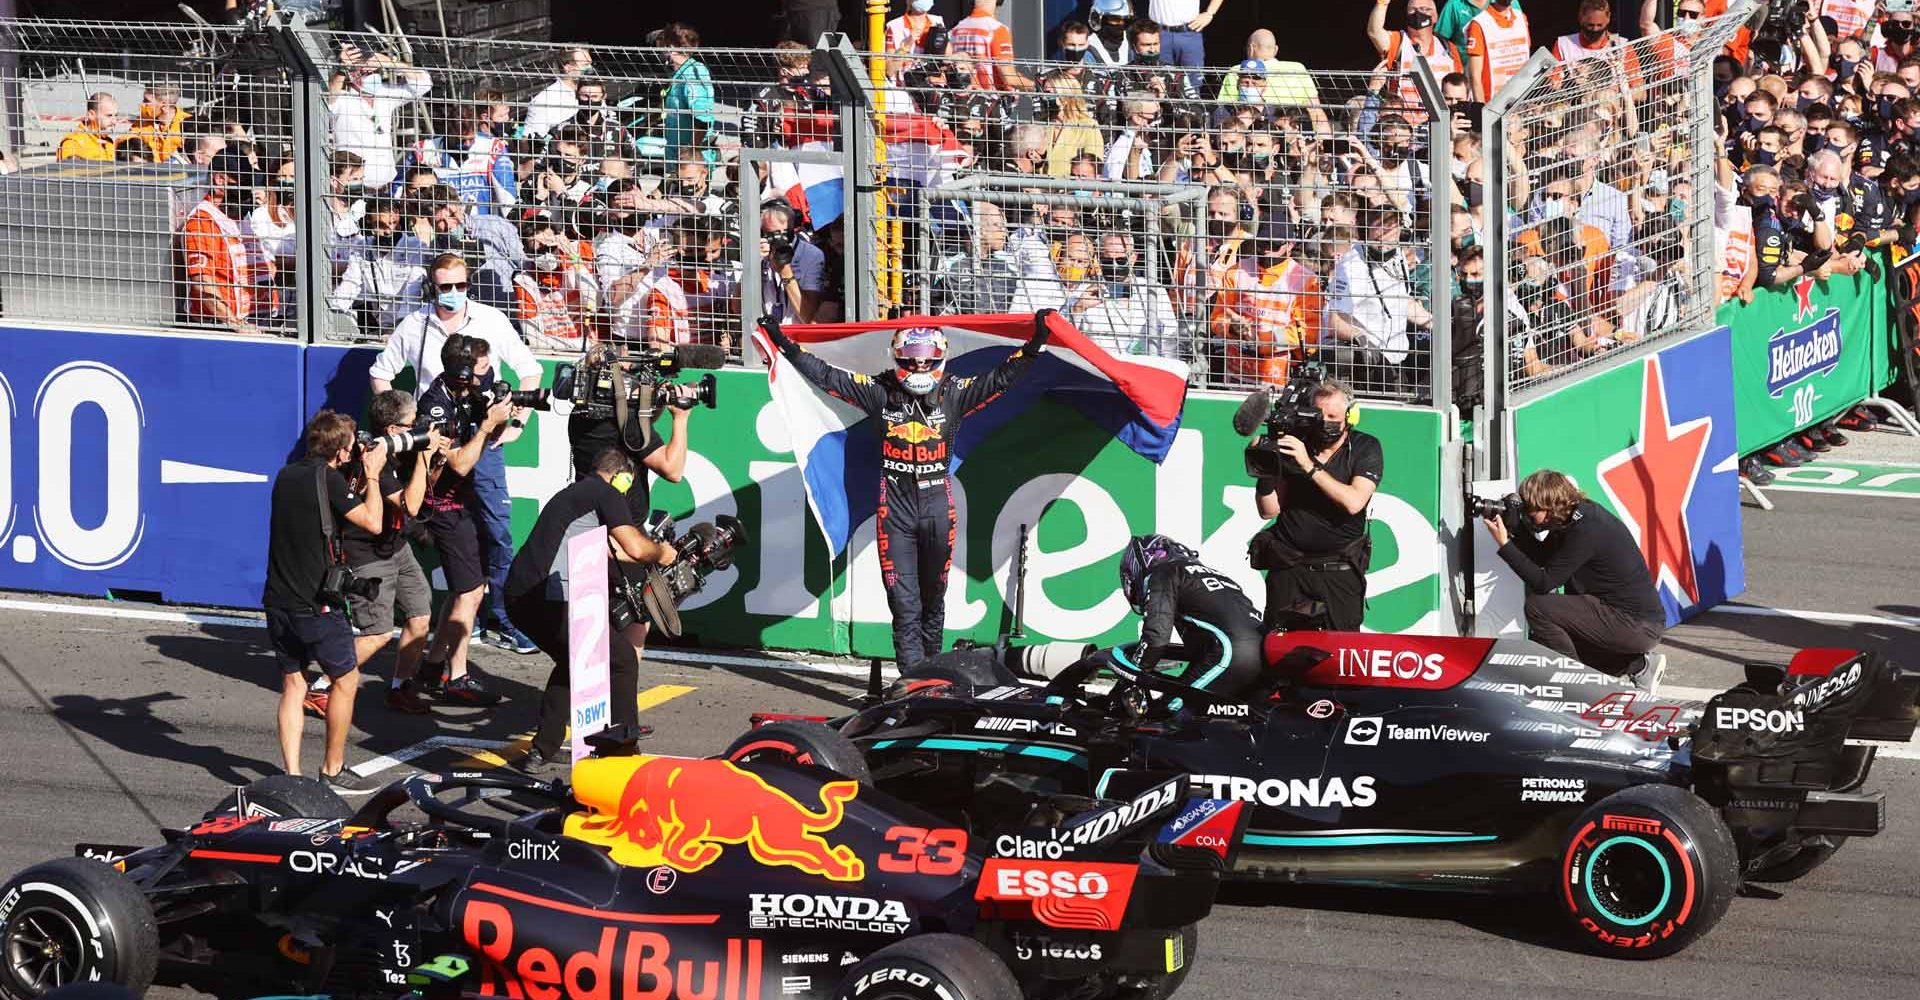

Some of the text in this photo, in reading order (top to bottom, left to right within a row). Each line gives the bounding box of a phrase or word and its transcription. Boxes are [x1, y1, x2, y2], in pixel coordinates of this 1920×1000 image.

[1770, 317, 1840, 385] Heineken
[883, 439, 946, 462] Red Bull
[0, 361, 146, 571] .0
[883, 459, 946, 474] HONDA
[1338, 648, 1446, 682] INEOS
[1518, 655, 1586, 671] AMG
[1496, 683, 1564, 699] AMG
[585, 701, 607, 725] BWT
[1207, 704, 1238, 717] AMD
[1716, 706, 1805, 733] EPSON
[1008, 718, 1077, 738] AMG
[1386, 724, 1491, 743] TeamViewer
[1522, 778, 1585, 789] PETRONAS
[1521, 789, 1587, 803] PRIMAX
[1073, 781, 1178, 845] HONDA
[1602, 814, 1662, 836] PIRELLI
[877, 825, 969, 876] 33
[996, 834, 1063, 860] Claro
[1195, 835, 1227, 847] COLA
[997, 868, 1109, 899] ESSO
[749, 893, 912, 923] HONDA
[1580, 916, 1652, 948] ZERO
[782, 953, 830, 964] SIEMENS
[1036, 934, 1103, 960] Tezos
[854, 967, 931, 996] ZERO
